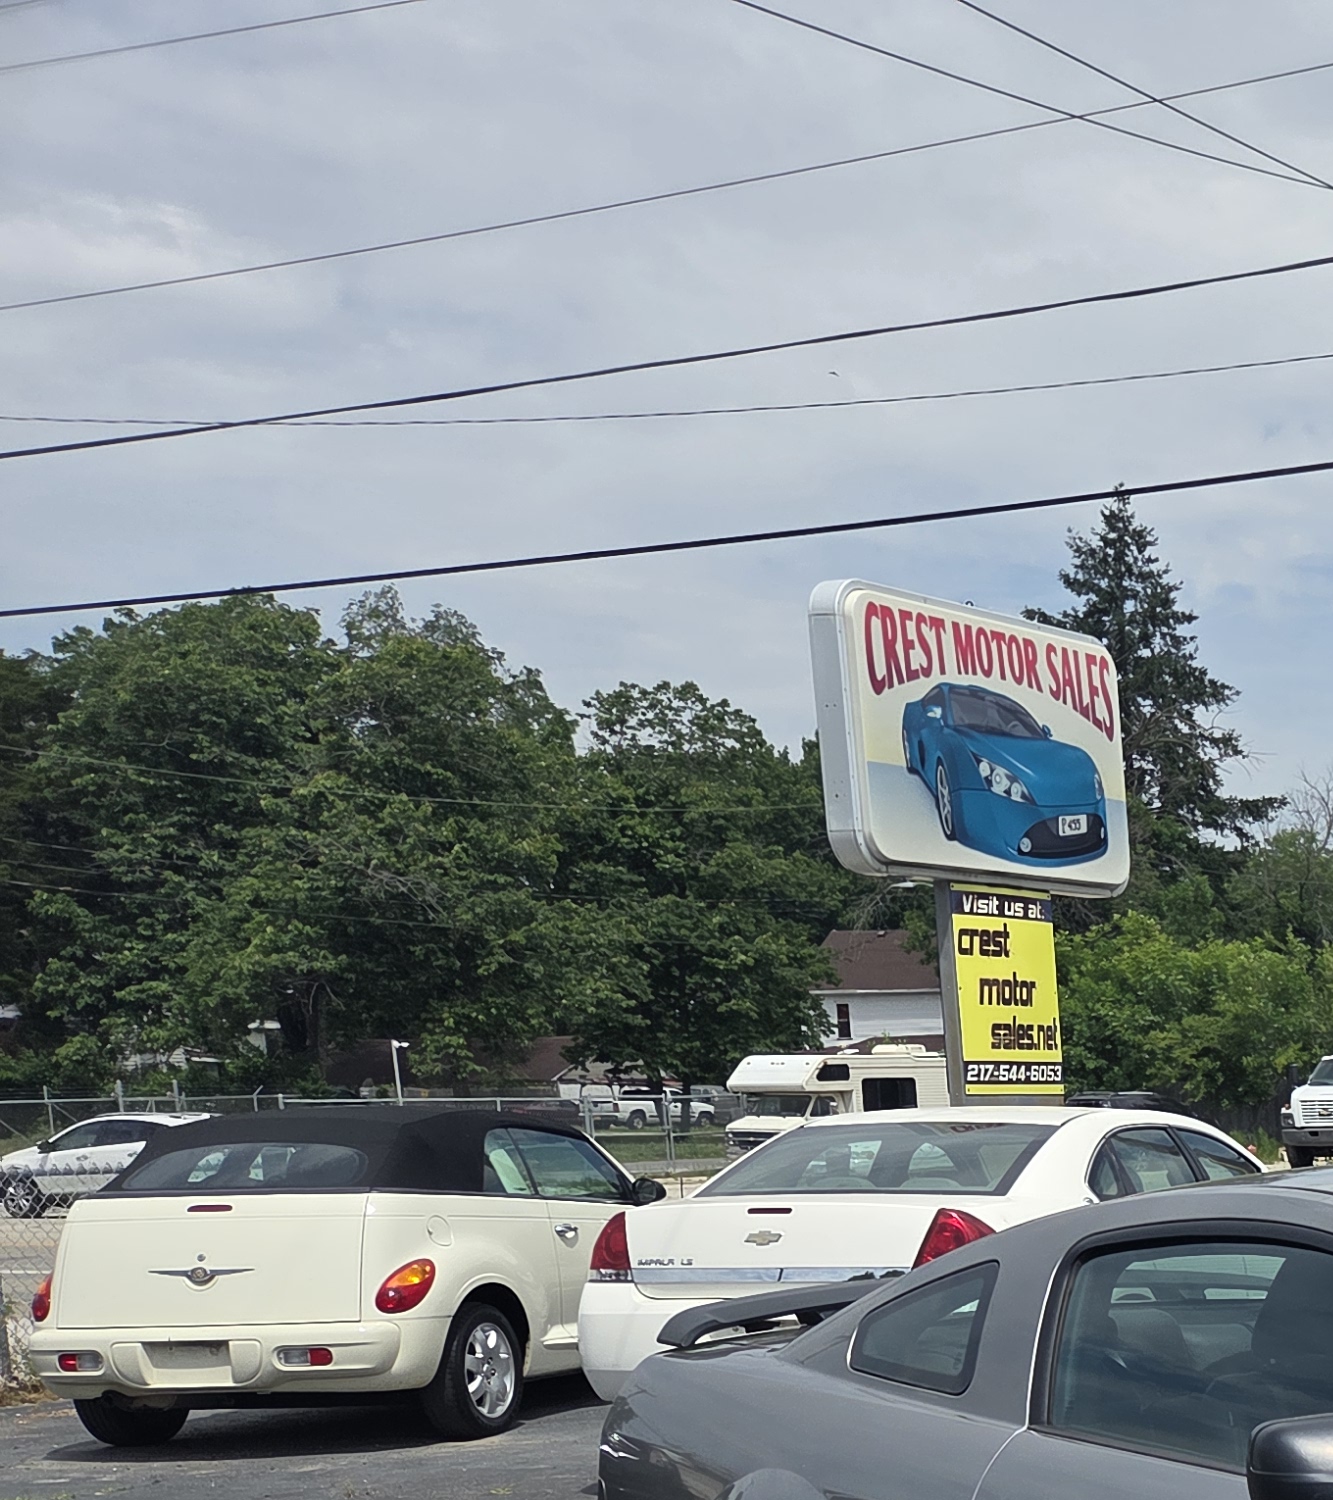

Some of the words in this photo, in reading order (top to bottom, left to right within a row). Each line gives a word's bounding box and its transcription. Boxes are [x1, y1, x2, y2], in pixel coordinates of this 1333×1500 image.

[864, 601, 947, 696] CREST
[952, 621, 1044, 694] MOTOR
[1046, 642, 1114, 743] SALES
[962, 894, 999, 914] Visit
[1004, 901, 1024, 917] us
[1028, 901, 1045, 919] at:
[958, 922, 1009, 958] crest
[979, 971, 1036, 1007] motor
[991, 1015, 1058, 1050] sales.net
[967, 1064, 1062, 1081] 217-544-6053
